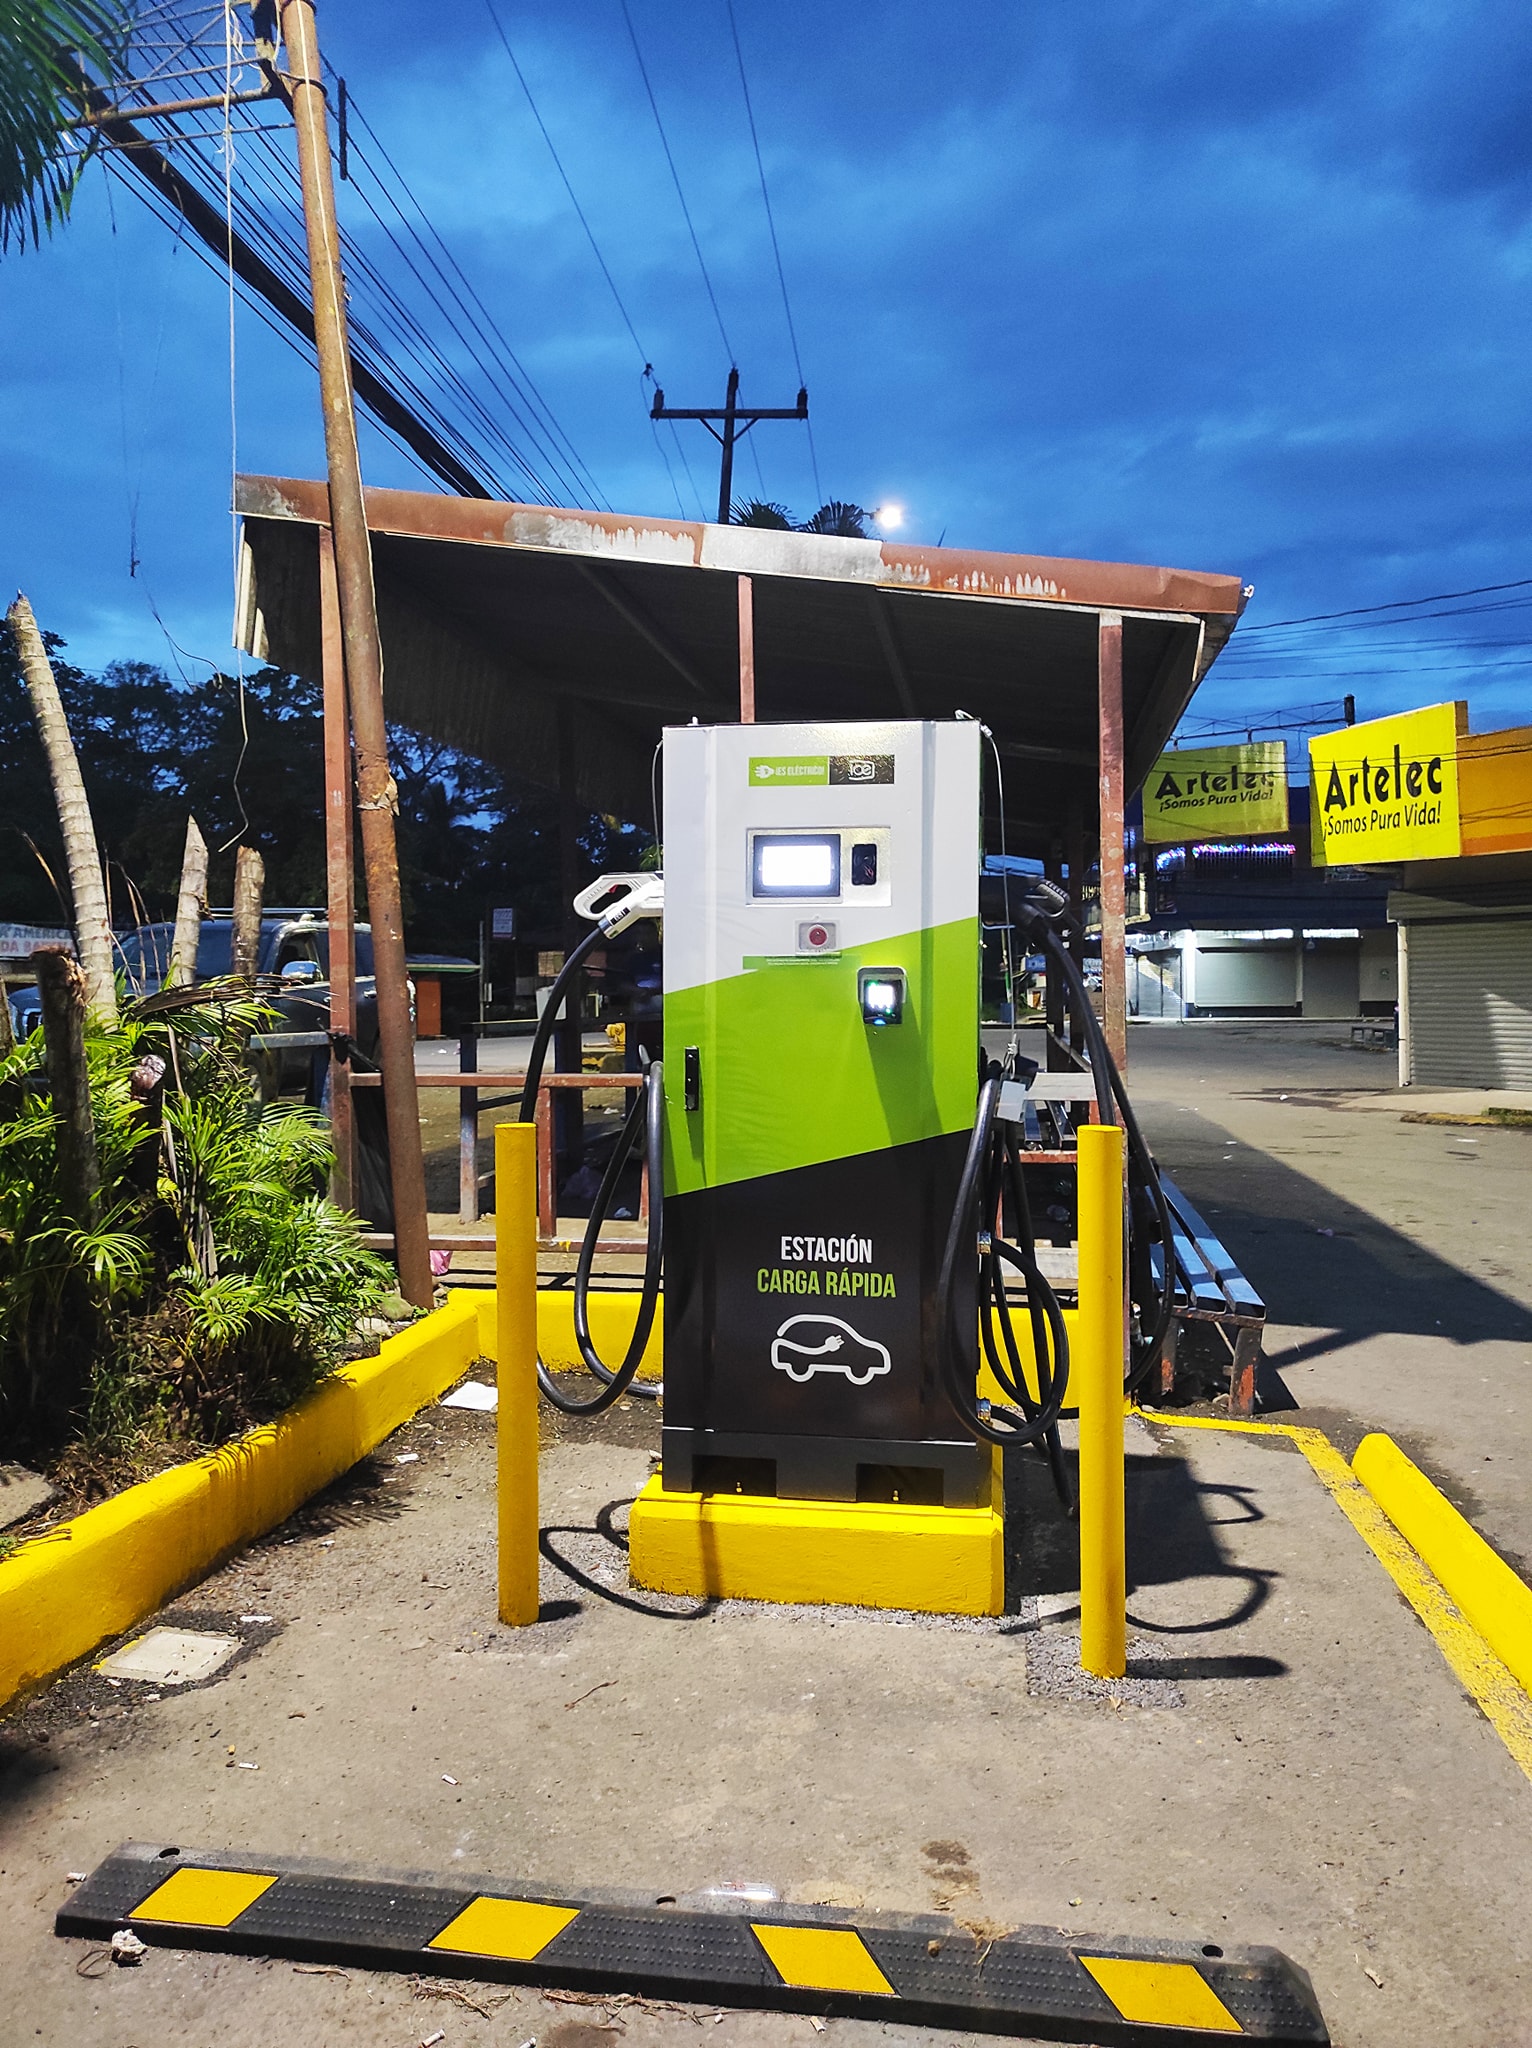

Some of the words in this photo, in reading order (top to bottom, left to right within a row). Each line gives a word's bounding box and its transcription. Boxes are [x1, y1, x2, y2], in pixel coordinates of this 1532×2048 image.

[1155, 765, 1274, 800] Artelec
[1324, 743, 1442, 814] Artelec
[1159, 797, 1204, 813] ¡Somos
[1207, 793, 1237, 805] Pura
[1240, 788, 1273, 802] Vida!
[1323, 815, 1367, 842] ¡Somos
[1370, 809, 1400, 831] Pura
[1404, 800, 1441, 827] Vida!
[781, 1233, 872, 1263] ESTACIÓN
[757, 1268, 821, 1295] CARGA
[825, 1267, 897, 1298] RÁPIDA
